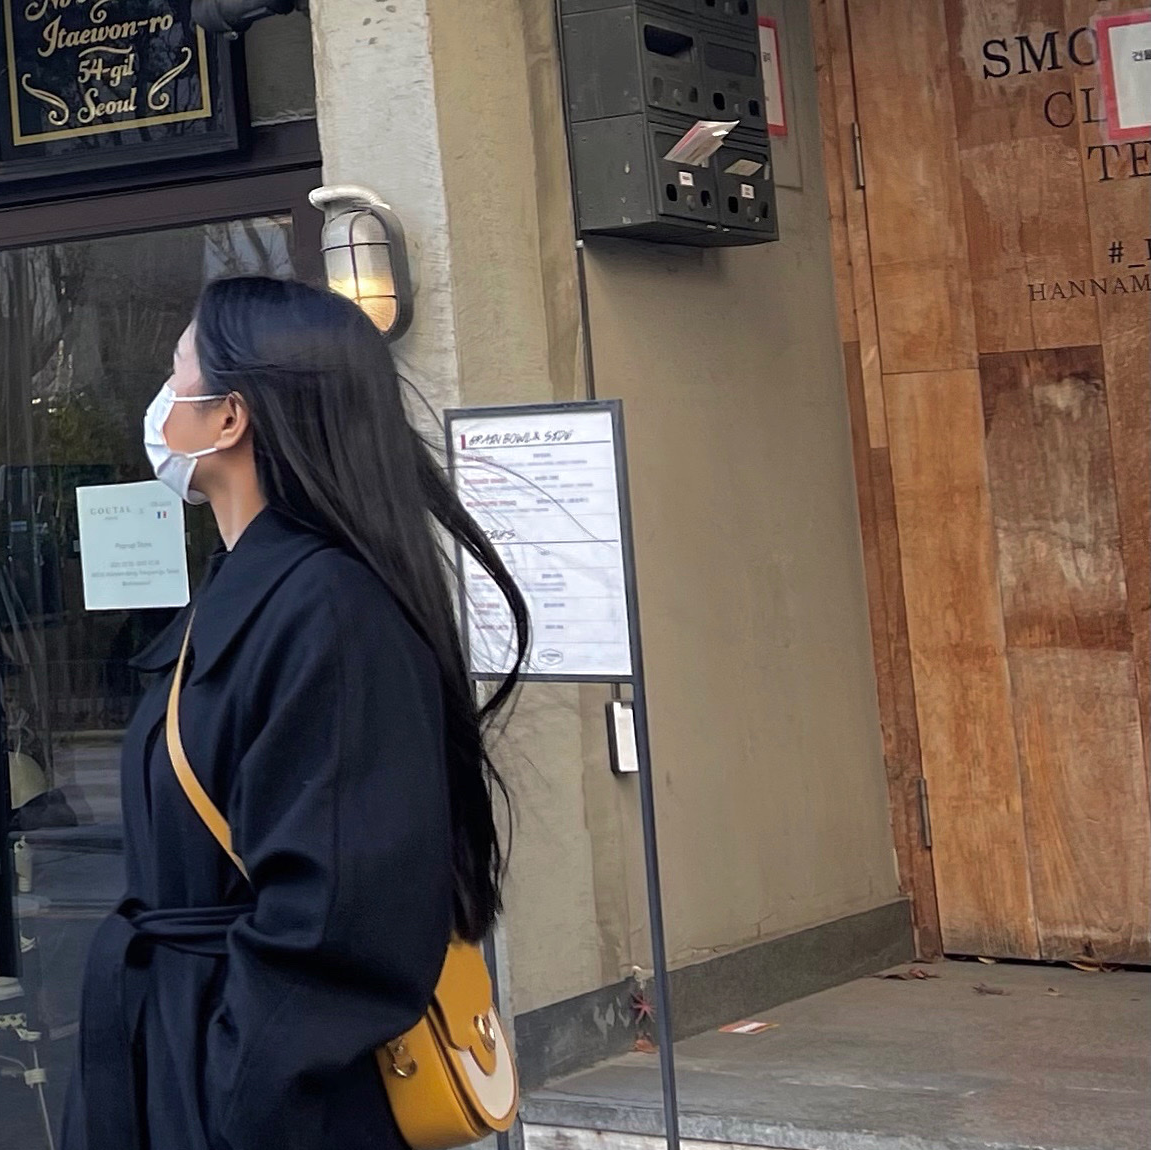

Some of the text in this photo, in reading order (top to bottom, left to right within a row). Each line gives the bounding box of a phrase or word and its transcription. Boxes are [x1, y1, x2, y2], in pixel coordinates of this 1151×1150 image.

[37, 14, 174, 58] Itaewon-ro
[77, 53, 136, 88] 54-gil
[77, 87, 138, 124] Seoul
[1028, 273, 1151, 303] HANNAM
